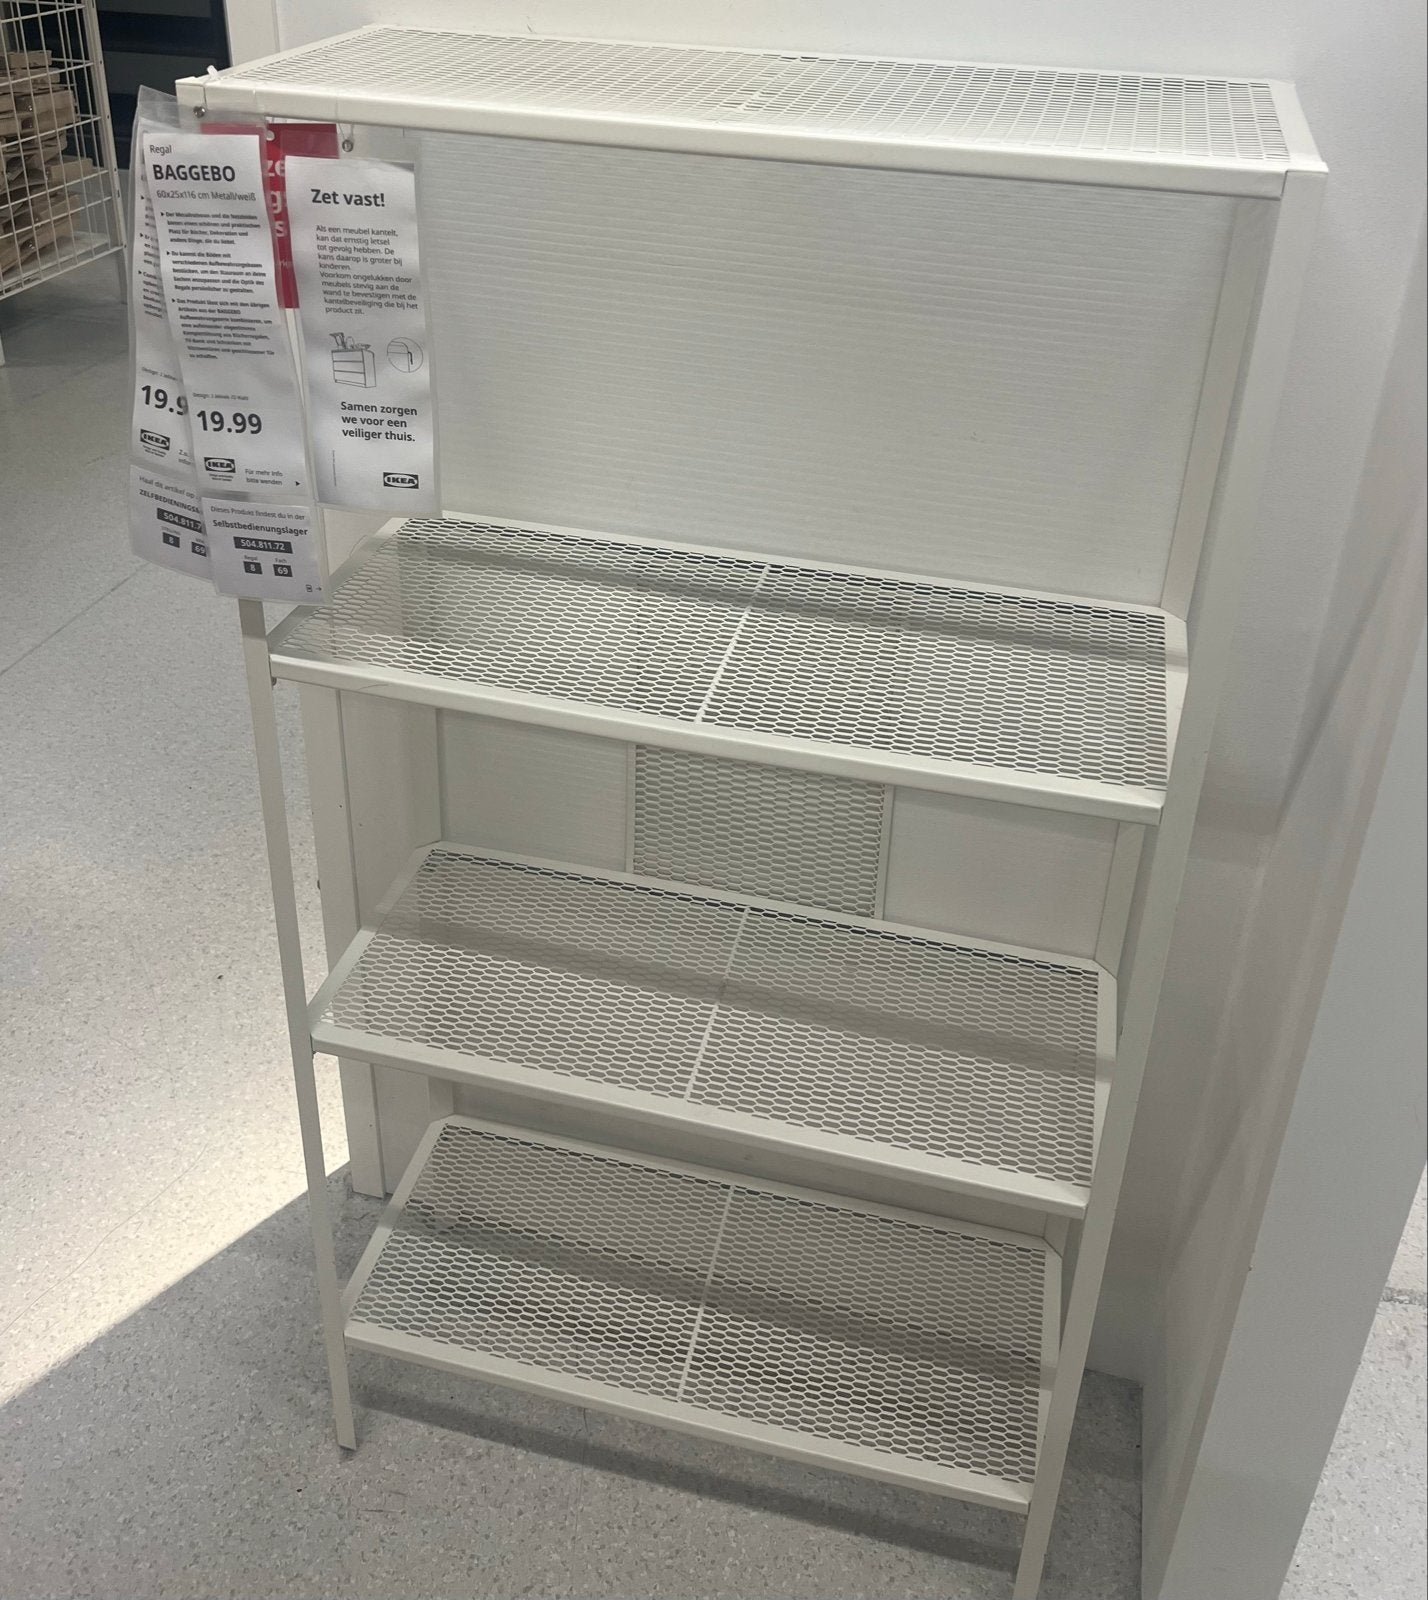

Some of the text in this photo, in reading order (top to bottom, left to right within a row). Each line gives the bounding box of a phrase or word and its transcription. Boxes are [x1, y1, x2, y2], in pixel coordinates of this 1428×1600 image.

[149, 144, 172, 156] Regal
[152, 164, 236, 182] BAGGEBO
[156, 190, 196, 199] 60x25x116
[211, 191, 256, 201] Metall/weiß
[310, 188, 385, 207] Zet vast!
[316, 225, 327, 233] Als
[342, 227, 370, 235] meubel
[328, 245, 352, 254] gevolg
[336, 255, 361, 263] daarop
[369, 257, 391, 265] groter
[393, 258, 403, 266] bij
[319, 271, 351, 280] Voorkom
[352, 274, 394, 282] ongelukken
[352, 282, 374, 291] stevig
[351, 291, 391, 300] bevestigen
[325, 306, 353, 314] product
[396, 302, 406, 310] bij
[141, 385, 188, 415] 19.9
[340, 401, 418, 417] Samen zorgen
[196, 410, 262, 435] 19.99
[341, 415, 407, 428] we voor een
[143, 432, 168, 446] IKEA
[342, 428, 416, 442] veiliger thuis.
[207, 460, 233, 470] IKEA
[245, 468, 255, 476] Für
[139, 475, 153, 485] Haal
[164, 485, 185, 495] artikel
[386, 475, 416, 486] IKEA
[210, 506, 229, 514] Dieses
[230, 507, 254, 516] Produkt
[255, 510, 277, 518] findest
[213, 520, 308, 536] Selbstbedienungslager
[240, 539, 285, 551] 504.811.72
[277, 566, 288, 575] 69
